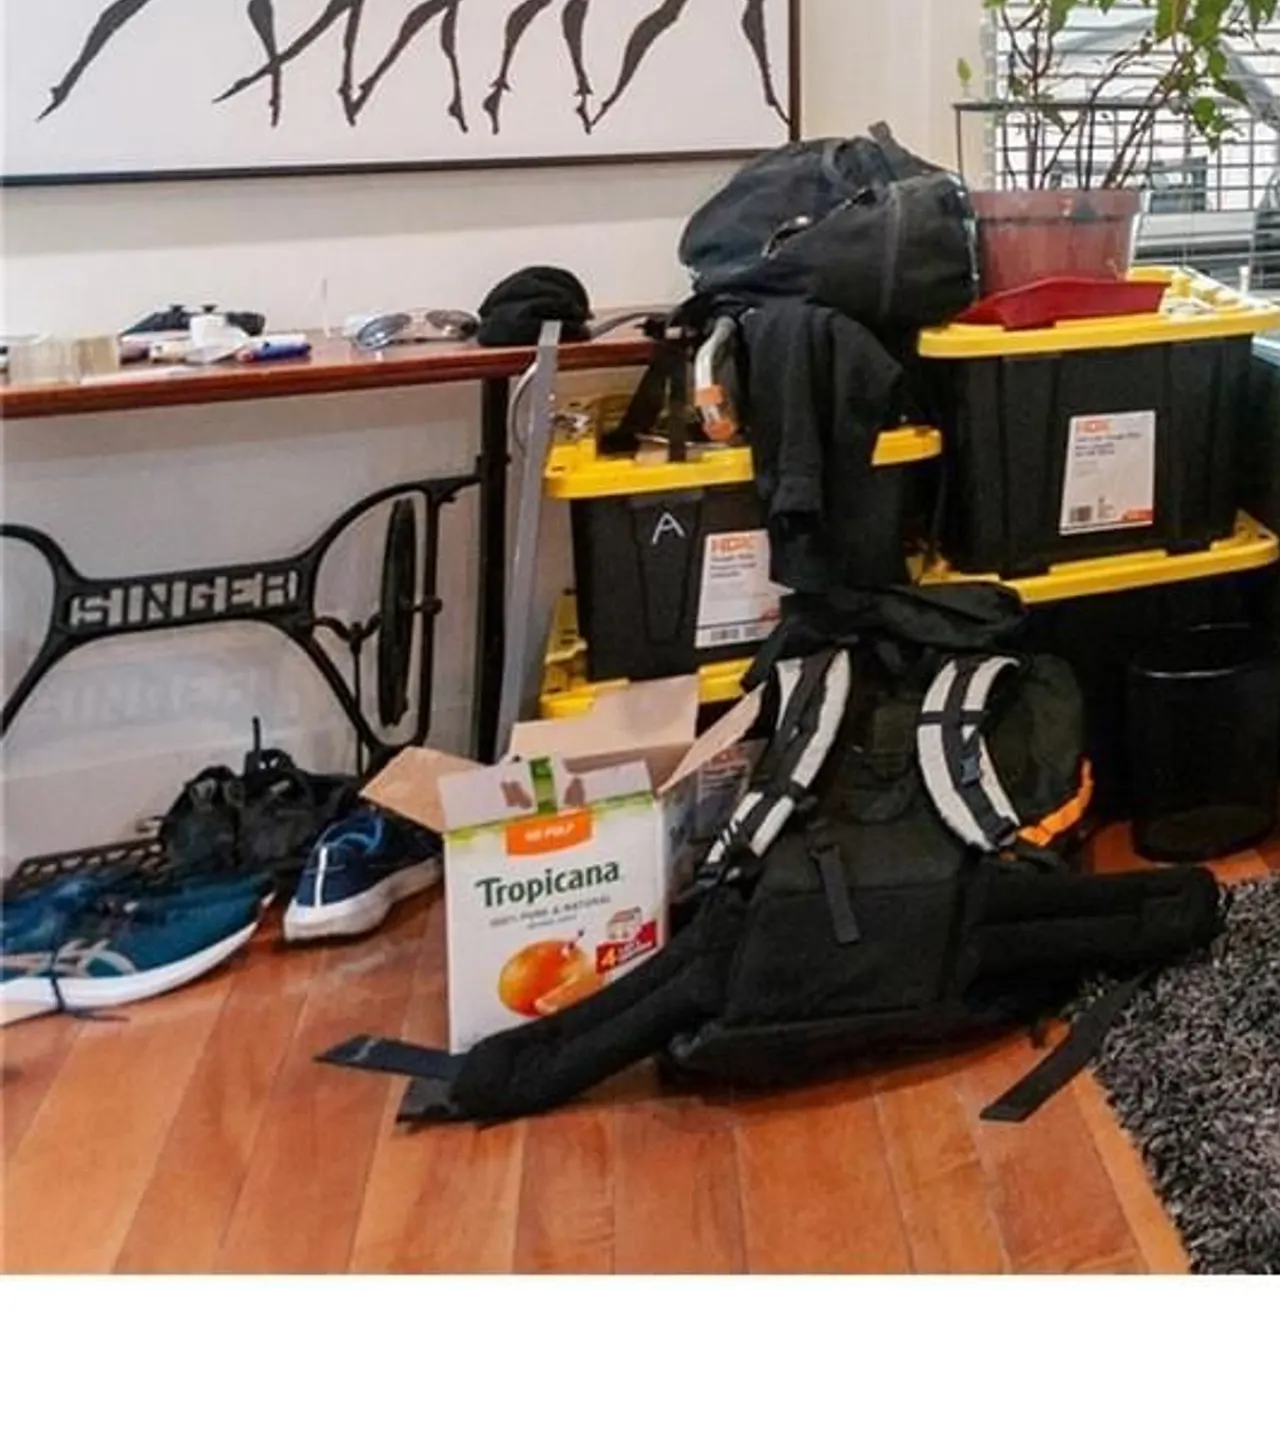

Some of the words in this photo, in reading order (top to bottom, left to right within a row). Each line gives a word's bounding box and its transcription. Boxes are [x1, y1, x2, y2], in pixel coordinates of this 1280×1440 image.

[653, 512, 685, 544] A
[70, 570, 299, 628] SINGER
[475, 861, 620, 907] Tropicana
[600, 945, 617, 967] 4
